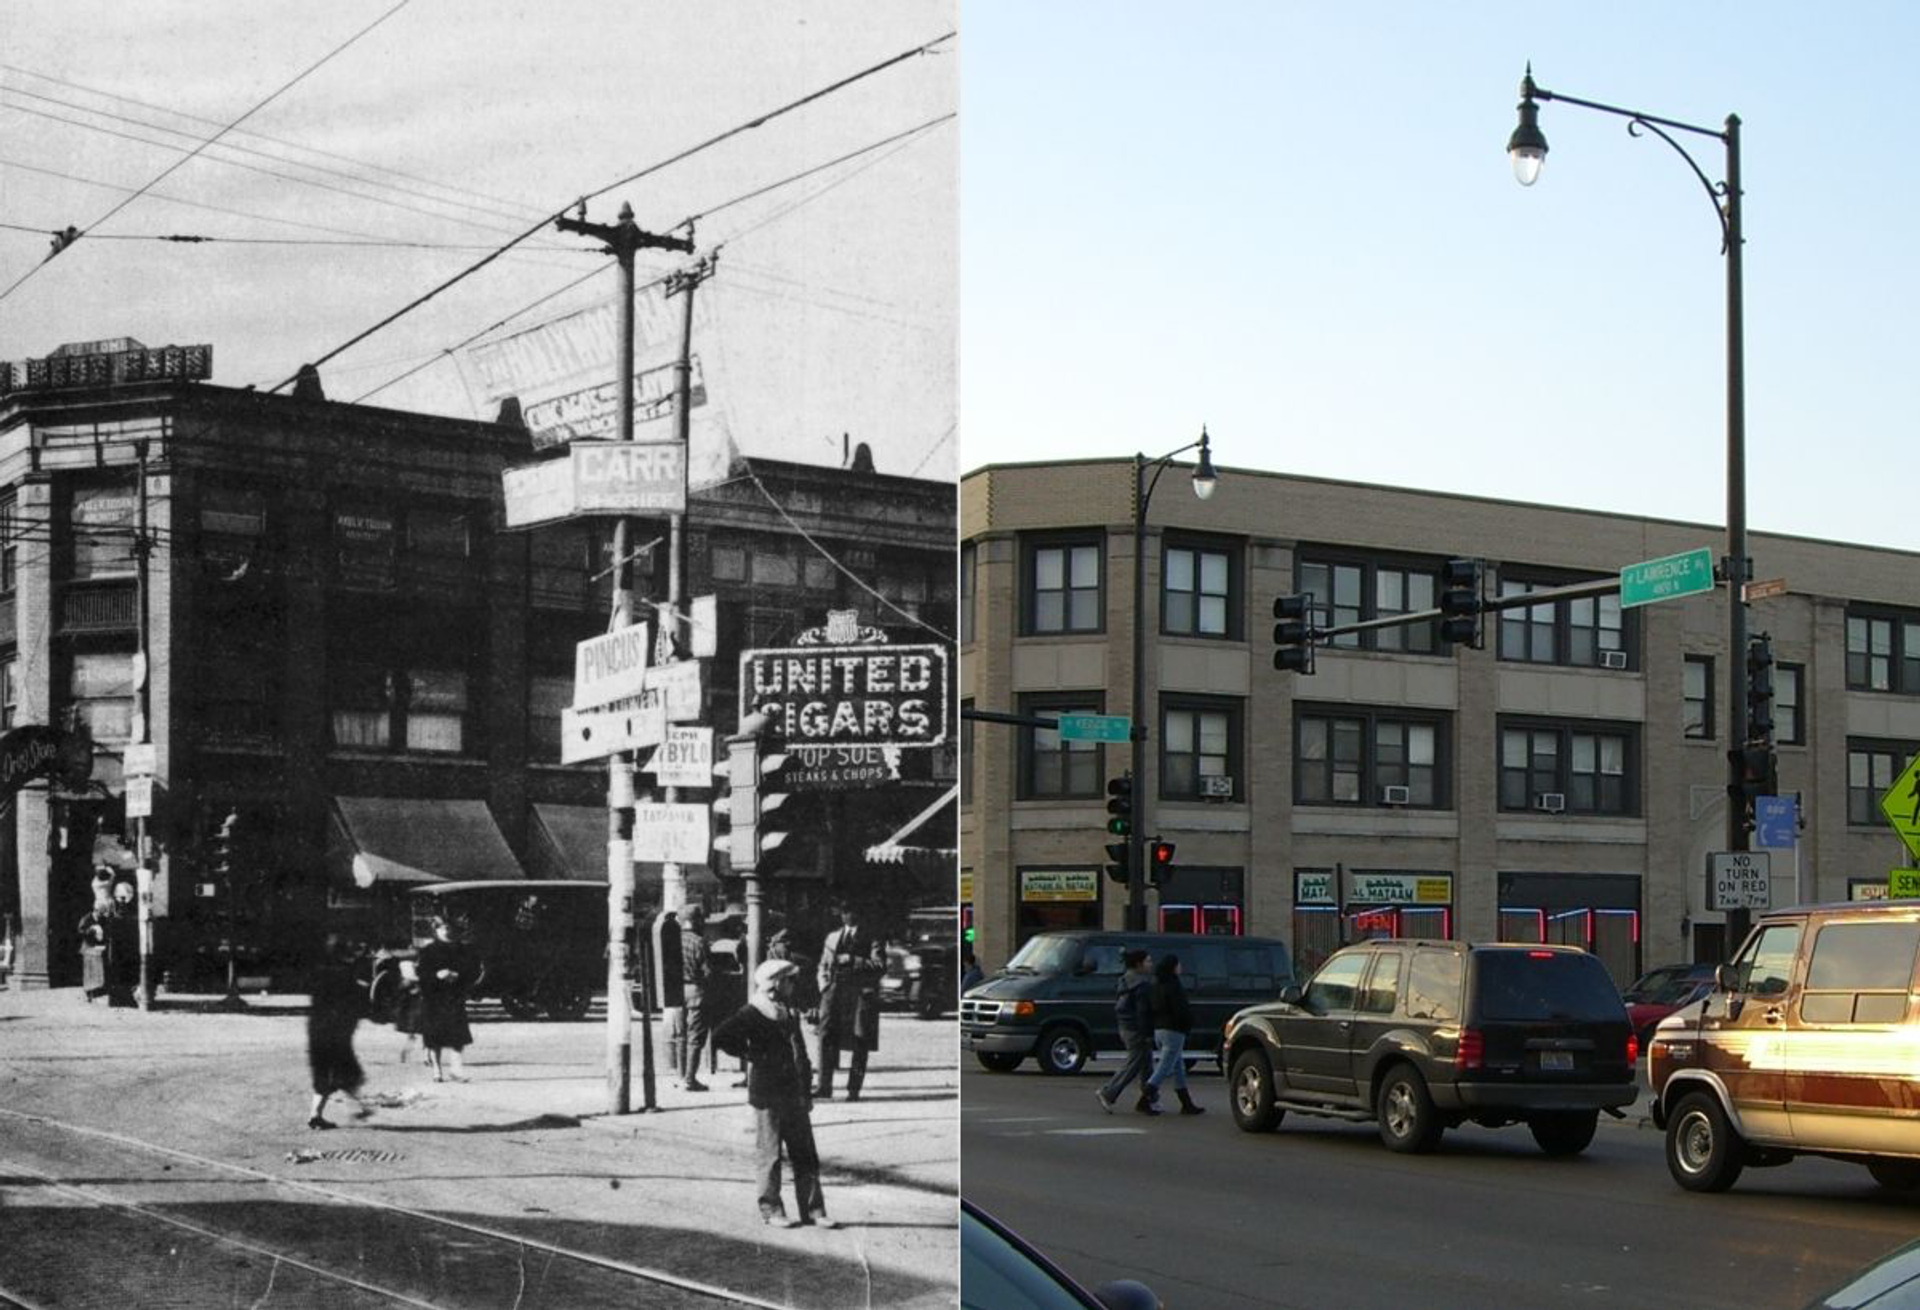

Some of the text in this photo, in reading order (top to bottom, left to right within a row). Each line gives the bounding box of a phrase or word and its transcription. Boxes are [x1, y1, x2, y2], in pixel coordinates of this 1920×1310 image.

[580, 449, 677, 481] CARR
[1636, 558, 1691, 584] LAWRENCE
[583, 631, 640, 684] PINCUS
[753, 655, 932, 695] UNITED
[3, 741, 57, 782] Drug Store
[837, 748, 881, 766] SUE
[785, 767, 884, 784] STEAKS & CHOPS
[1733, 856, 1750, 867] NO
[1725, 868, 1760, 880] TURN
[1368, 888, 1414, 900] MATAAM
[1718, 880, 1767, 892] ON RED
